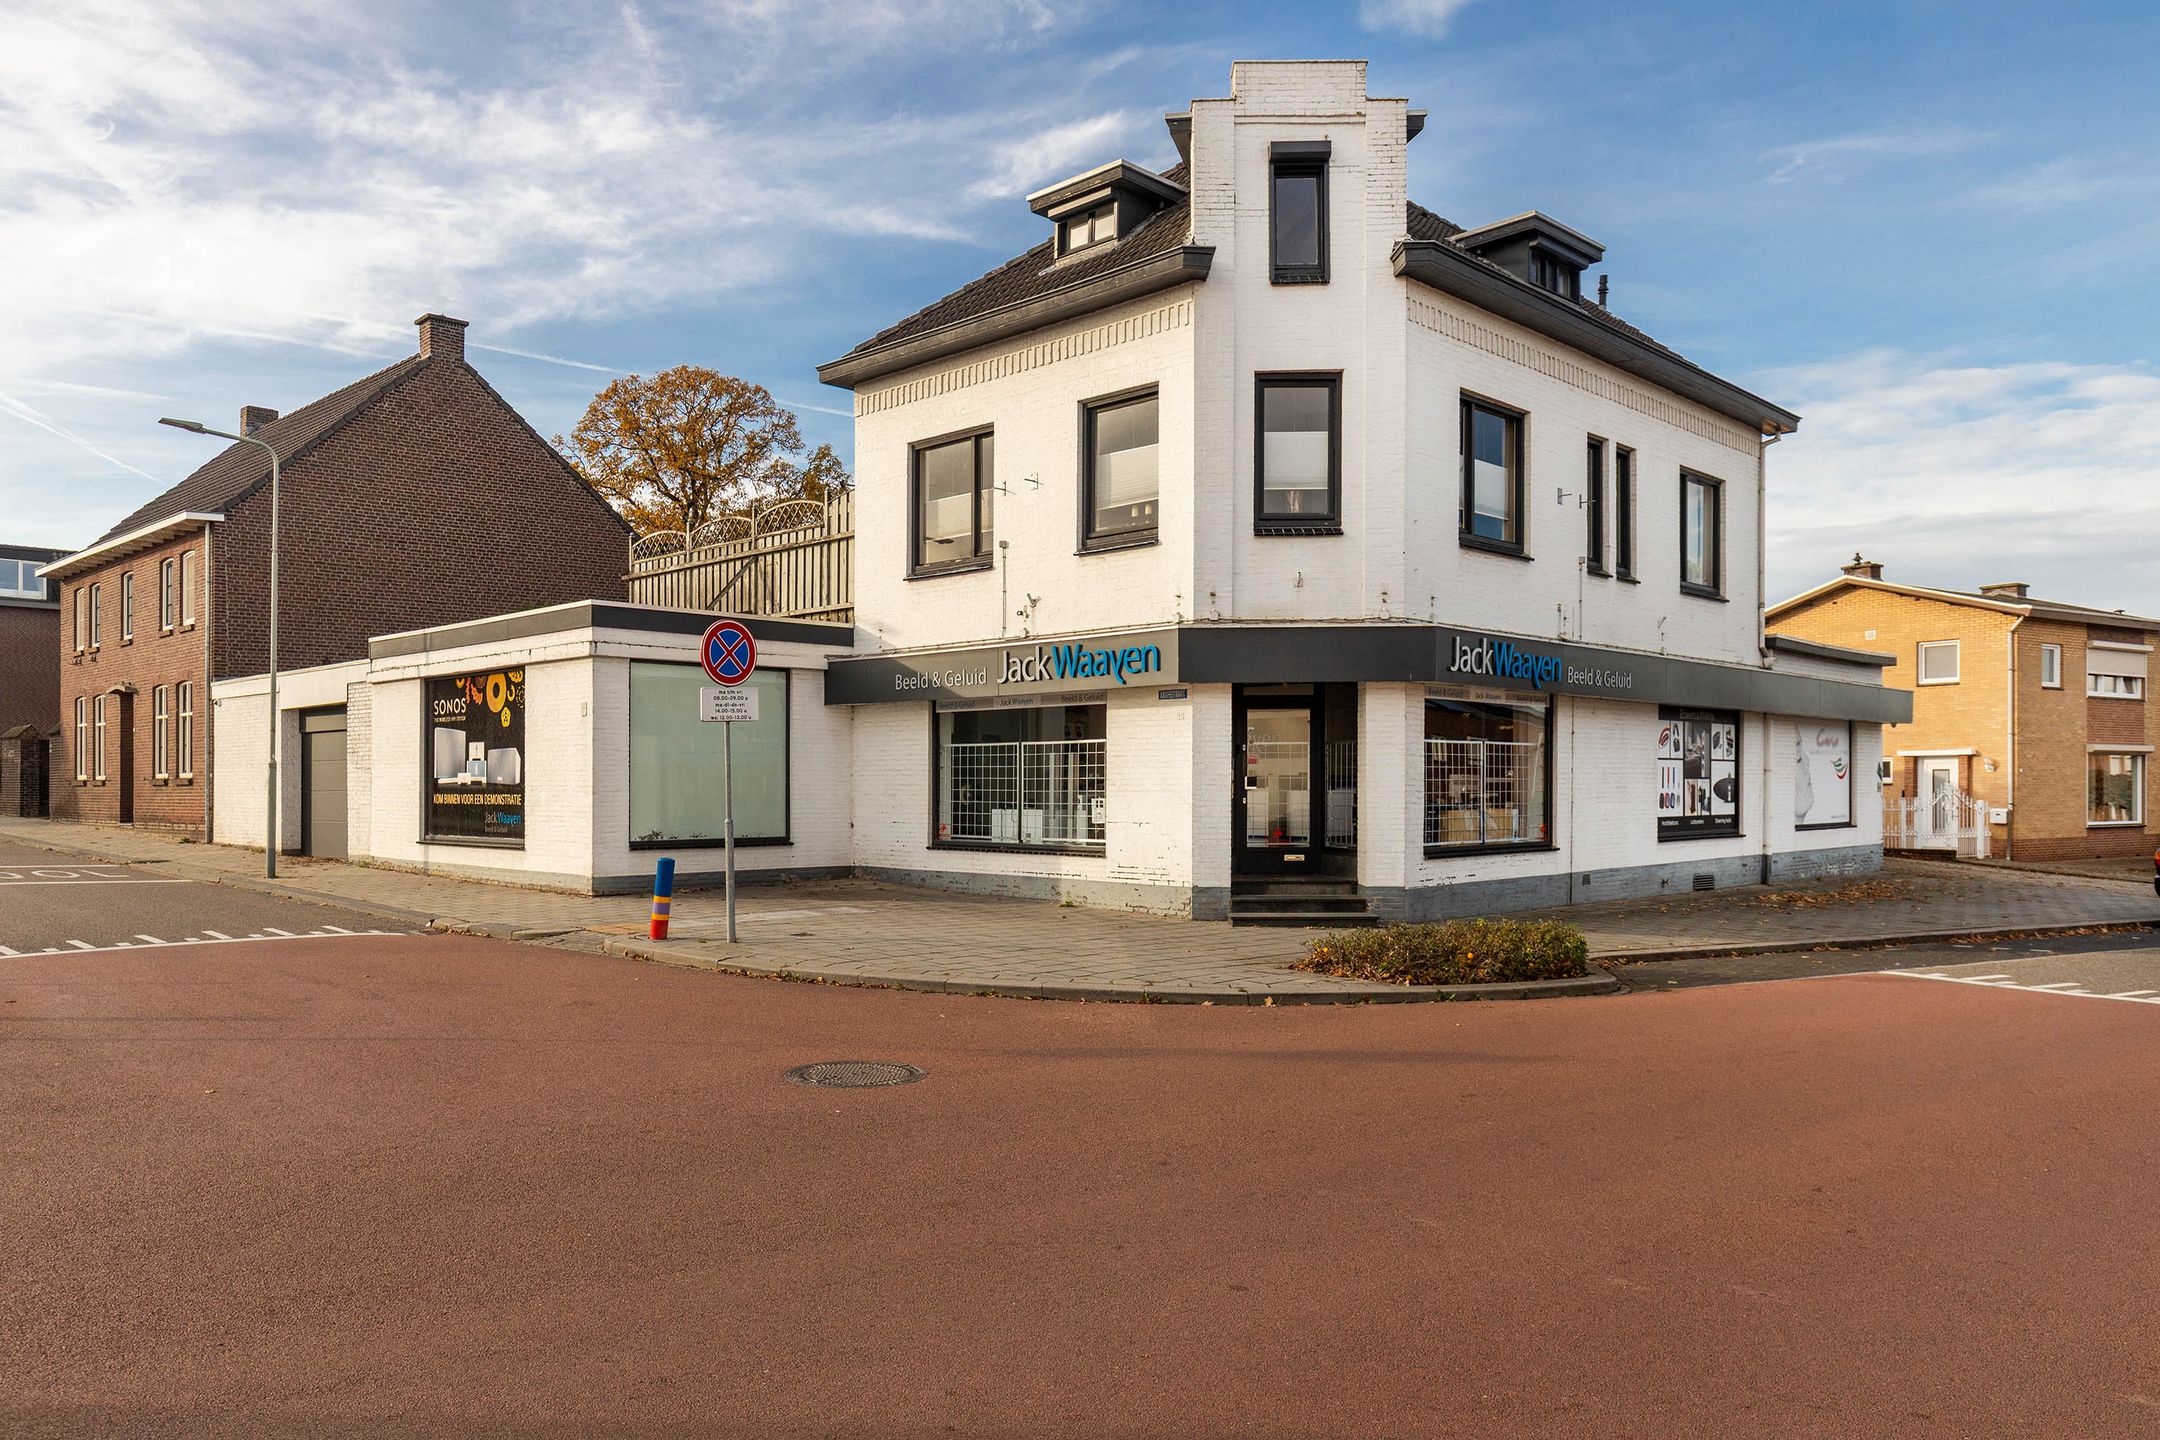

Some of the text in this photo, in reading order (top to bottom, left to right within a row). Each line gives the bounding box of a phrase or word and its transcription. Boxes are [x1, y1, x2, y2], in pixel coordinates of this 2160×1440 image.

[996, 643, 1160, 685] Jack Waayen
[1450, 635, 1562, 690] Jack Waayen
[895, 667, 987, 690] Beeld & Geluid
[1567, 666, 1632, 689] Beeld & Geluid
[433, 697, 467, 715] SONOS
[999, 699, 1012, 707] Jack
[1061, 694, 1078, 703] Beeld
[1084, 692, 1104, 702] Geluid
[433, 793, 522, 806] KOM BINNEN VOOR EEN DEMONSTRATIE
[484, 811, 497, 824] Jack
